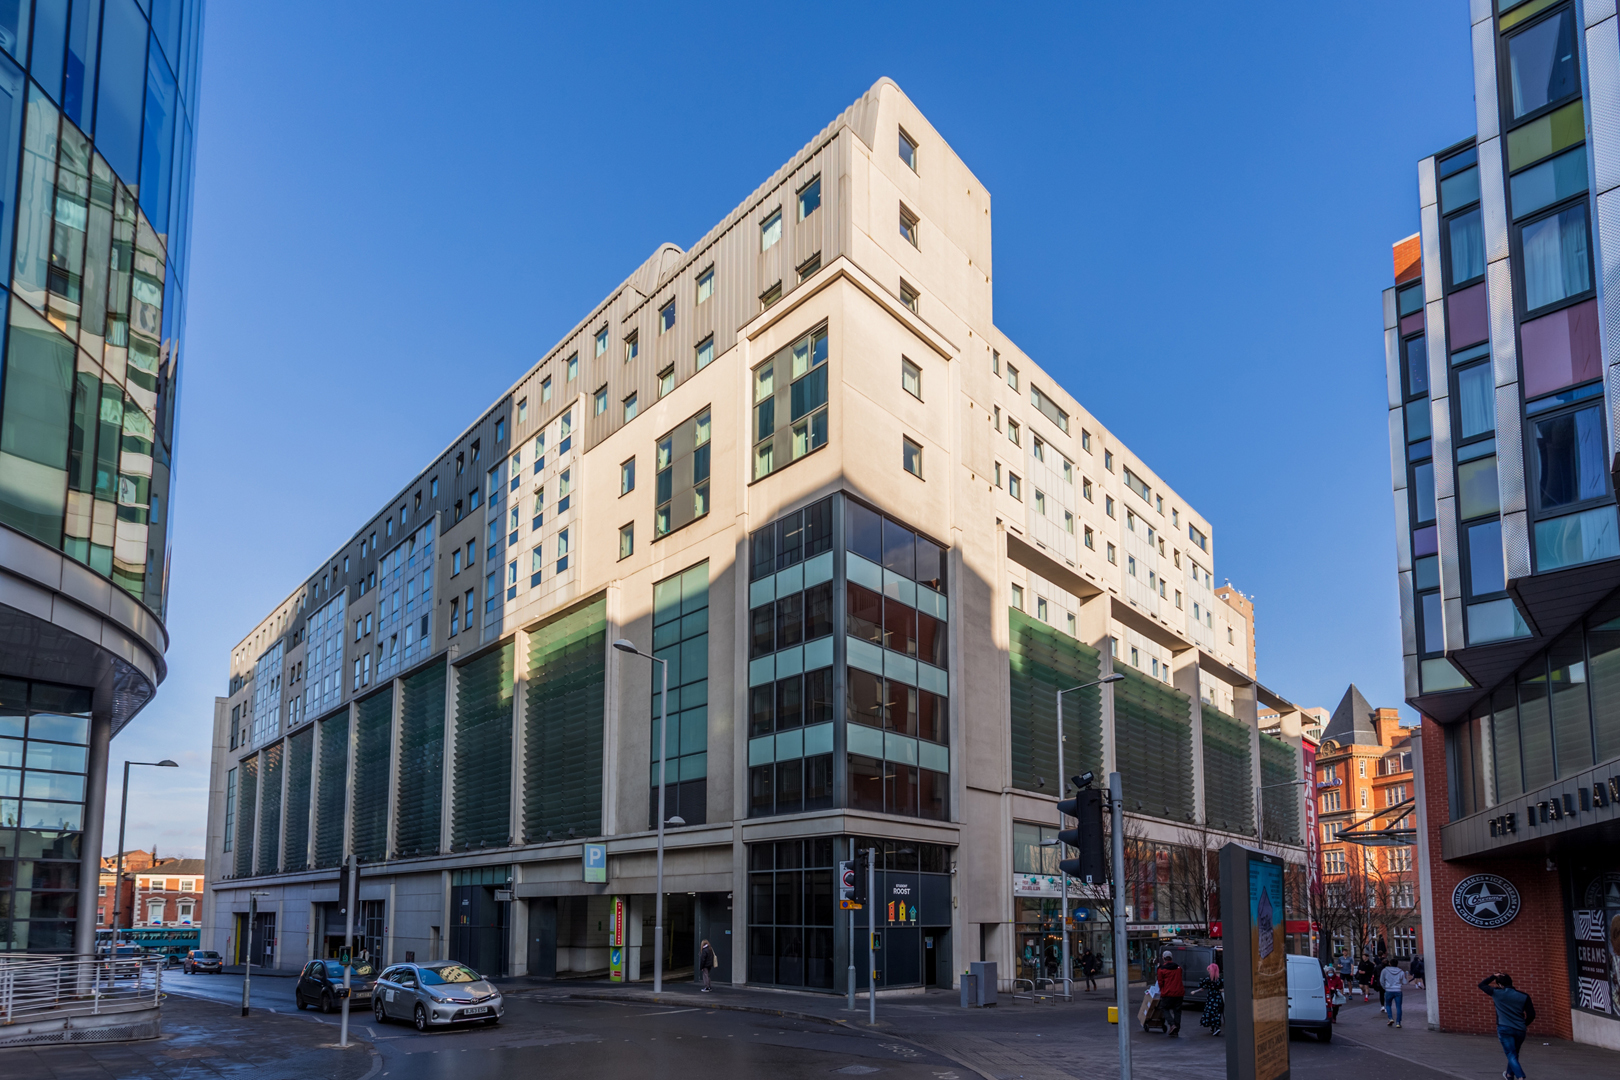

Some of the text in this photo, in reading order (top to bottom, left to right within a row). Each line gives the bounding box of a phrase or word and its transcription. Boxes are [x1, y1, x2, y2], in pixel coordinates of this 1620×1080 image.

[1488, 775, 1620, 837] THE ITALIAN
[590, 848, 601, 865] P
[893, 887, 911, 895] ROOST
[1455, 876, 1484, 905] MILKSHAKES
[1503, 882, 1517, 905] CREAM
[1466, 893, 1503, 907] Creams
[1459, 909, 1483, 925] CREPES
[1489, 909, 1514, 925] COFFEE
[1578, 946, 1606, 963] CREAMS
